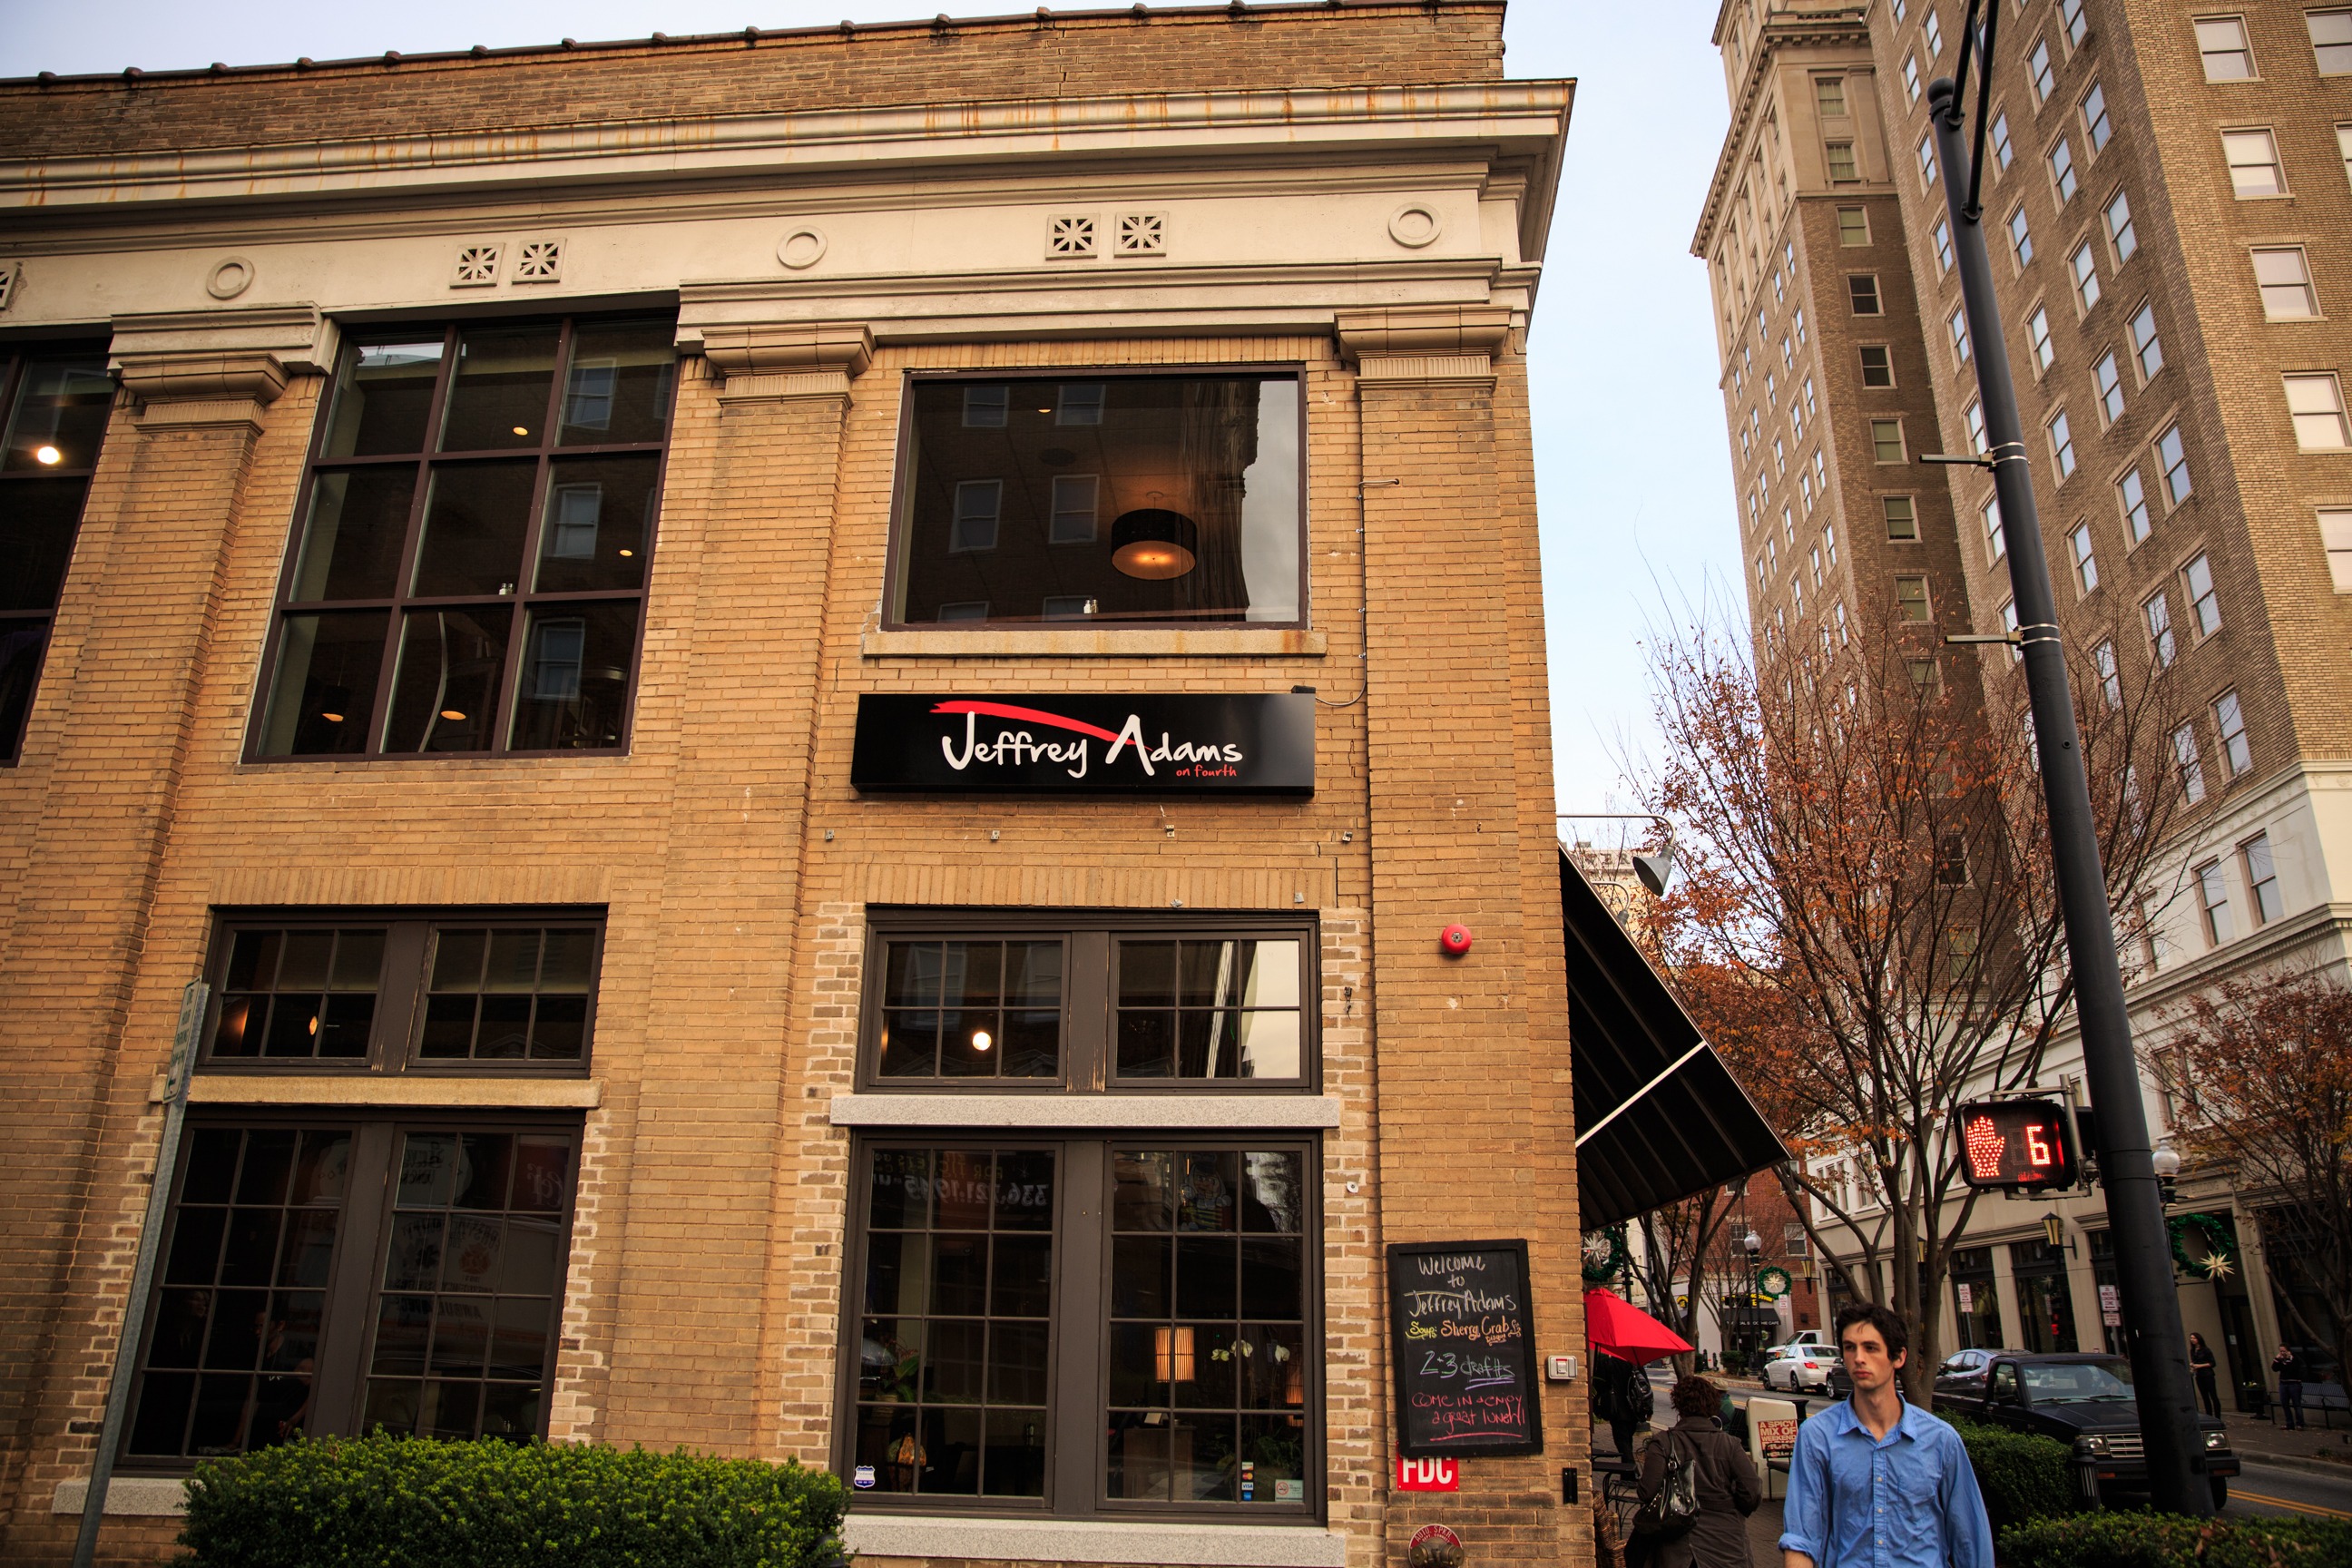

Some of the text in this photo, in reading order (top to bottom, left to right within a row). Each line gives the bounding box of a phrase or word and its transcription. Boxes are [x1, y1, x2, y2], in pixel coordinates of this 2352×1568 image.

[941, 711, 1243, 779] Jeffrey Adams
[1176, 763, 1237, 778] on fourth
[2026, 1125, 2051, 1165] 6
[1417, 1255, 1486, 1276] Welcome
[1447, 1274, 1465, 1289] to
[1408, 1289, 1461, 1319] Jeffrey
[1481, 1315, 1510, 1336] Crab
[1760, 1426, 1797, 1436] MIX OF
[1768, 1420, 1794, 1428] SPICY
[1402, 1456, 1453, 1485] FDC
